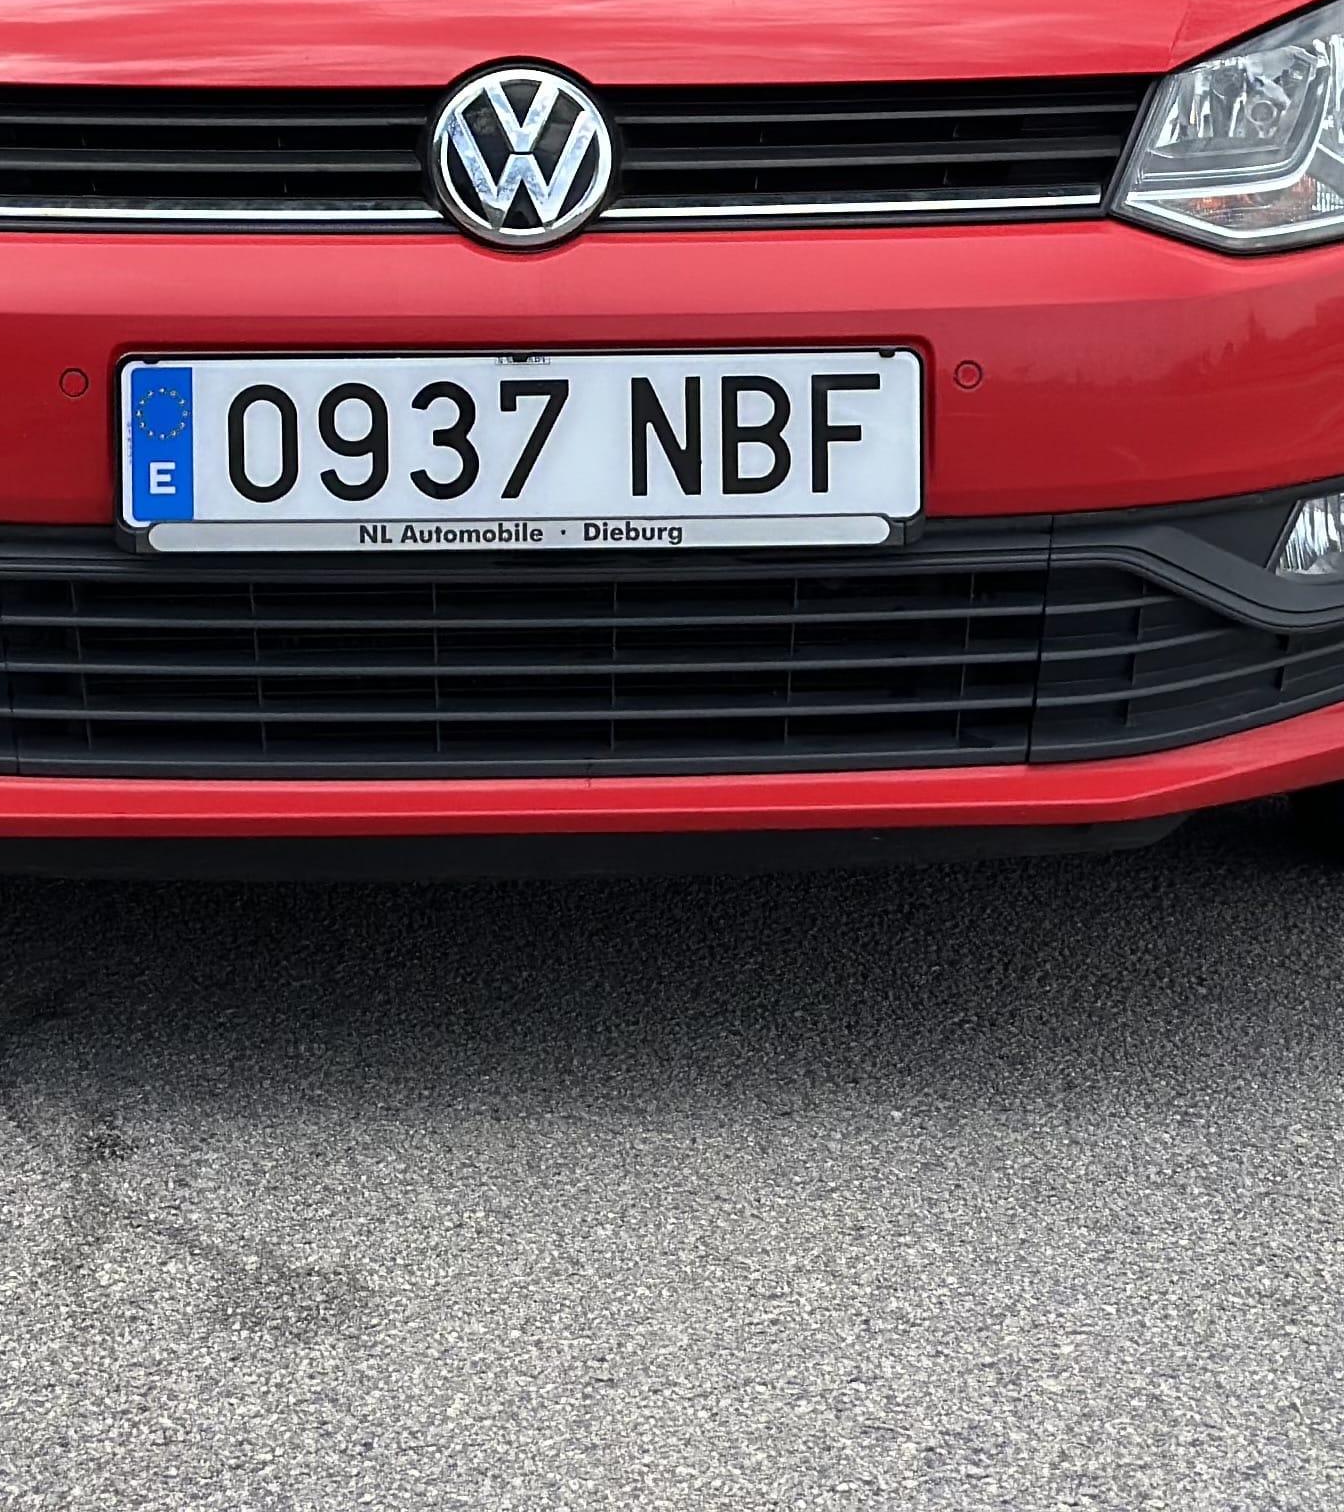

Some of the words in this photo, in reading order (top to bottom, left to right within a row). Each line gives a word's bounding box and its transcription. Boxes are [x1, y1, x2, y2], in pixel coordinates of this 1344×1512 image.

[227, 378, 571, 504] 0937
[630, 372, 881, 497] NBF
[149, 461, 176, 495] E
[359, 524, 392, 544] NL
[400, 522, 544, 544] Automobile
[583, 521, 683, 545] Dieburg
